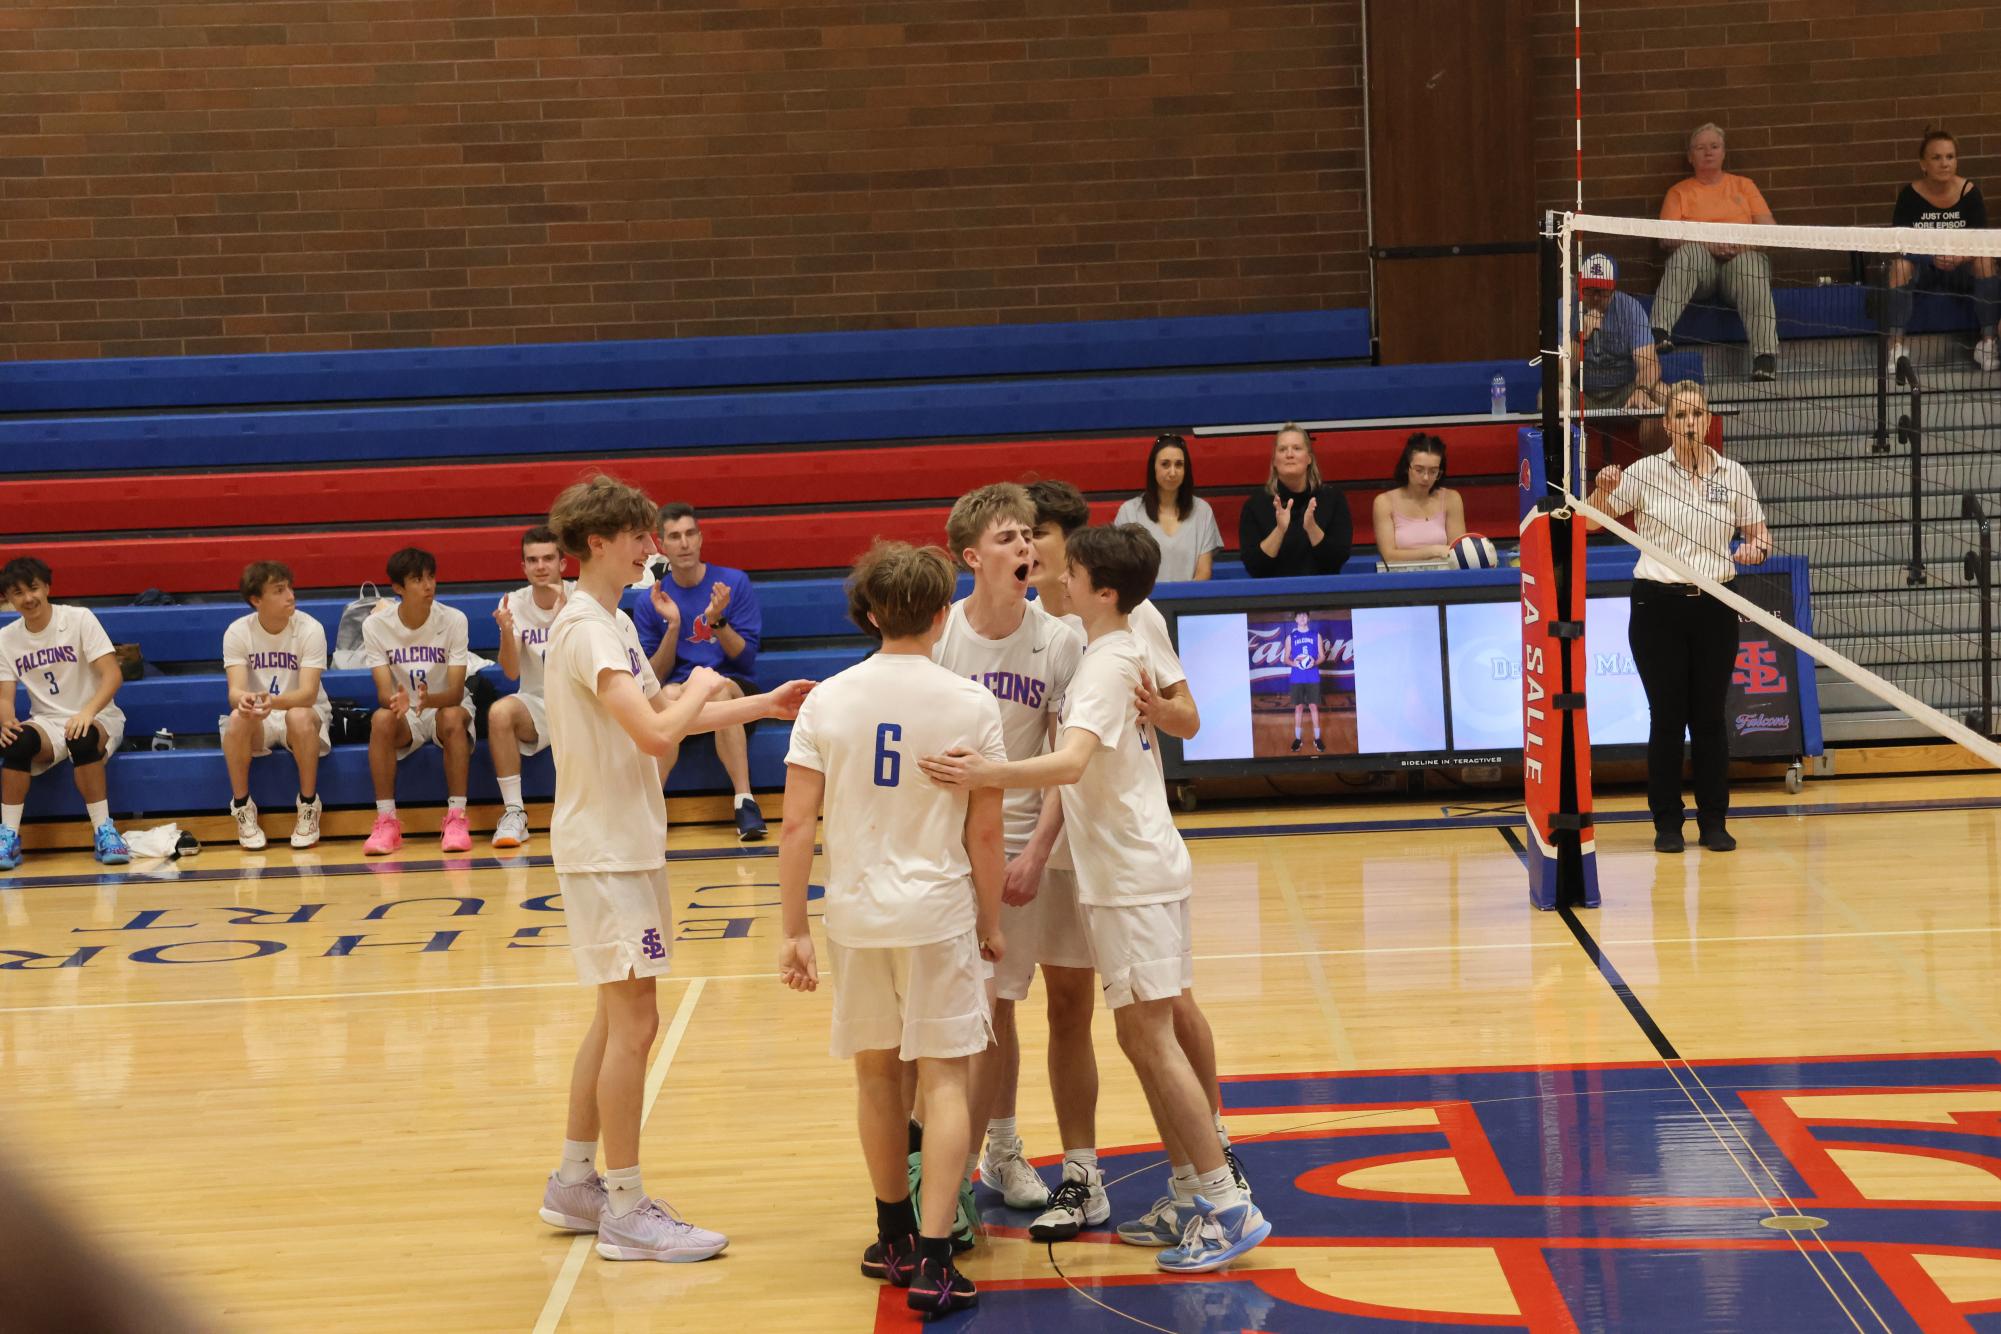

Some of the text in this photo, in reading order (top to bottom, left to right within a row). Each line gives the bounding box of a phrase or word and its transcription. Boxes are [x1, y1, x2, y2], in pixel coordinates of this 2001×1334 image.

[1921, 211, 1960, 220] JUST ONE
[15, 645, 78, 677] FALCONS
[385, 646, 447, 666] FALCONS
[44, 671, 60, 695] 3
[269, 675, 280, 696] 4
[970, 671, 1046, 709] CONS
[1521, 572, 1545, 784] LA SALLE
[1735, 713, 1790, 735] Falcons
[873, 722, 902, 787] 6
